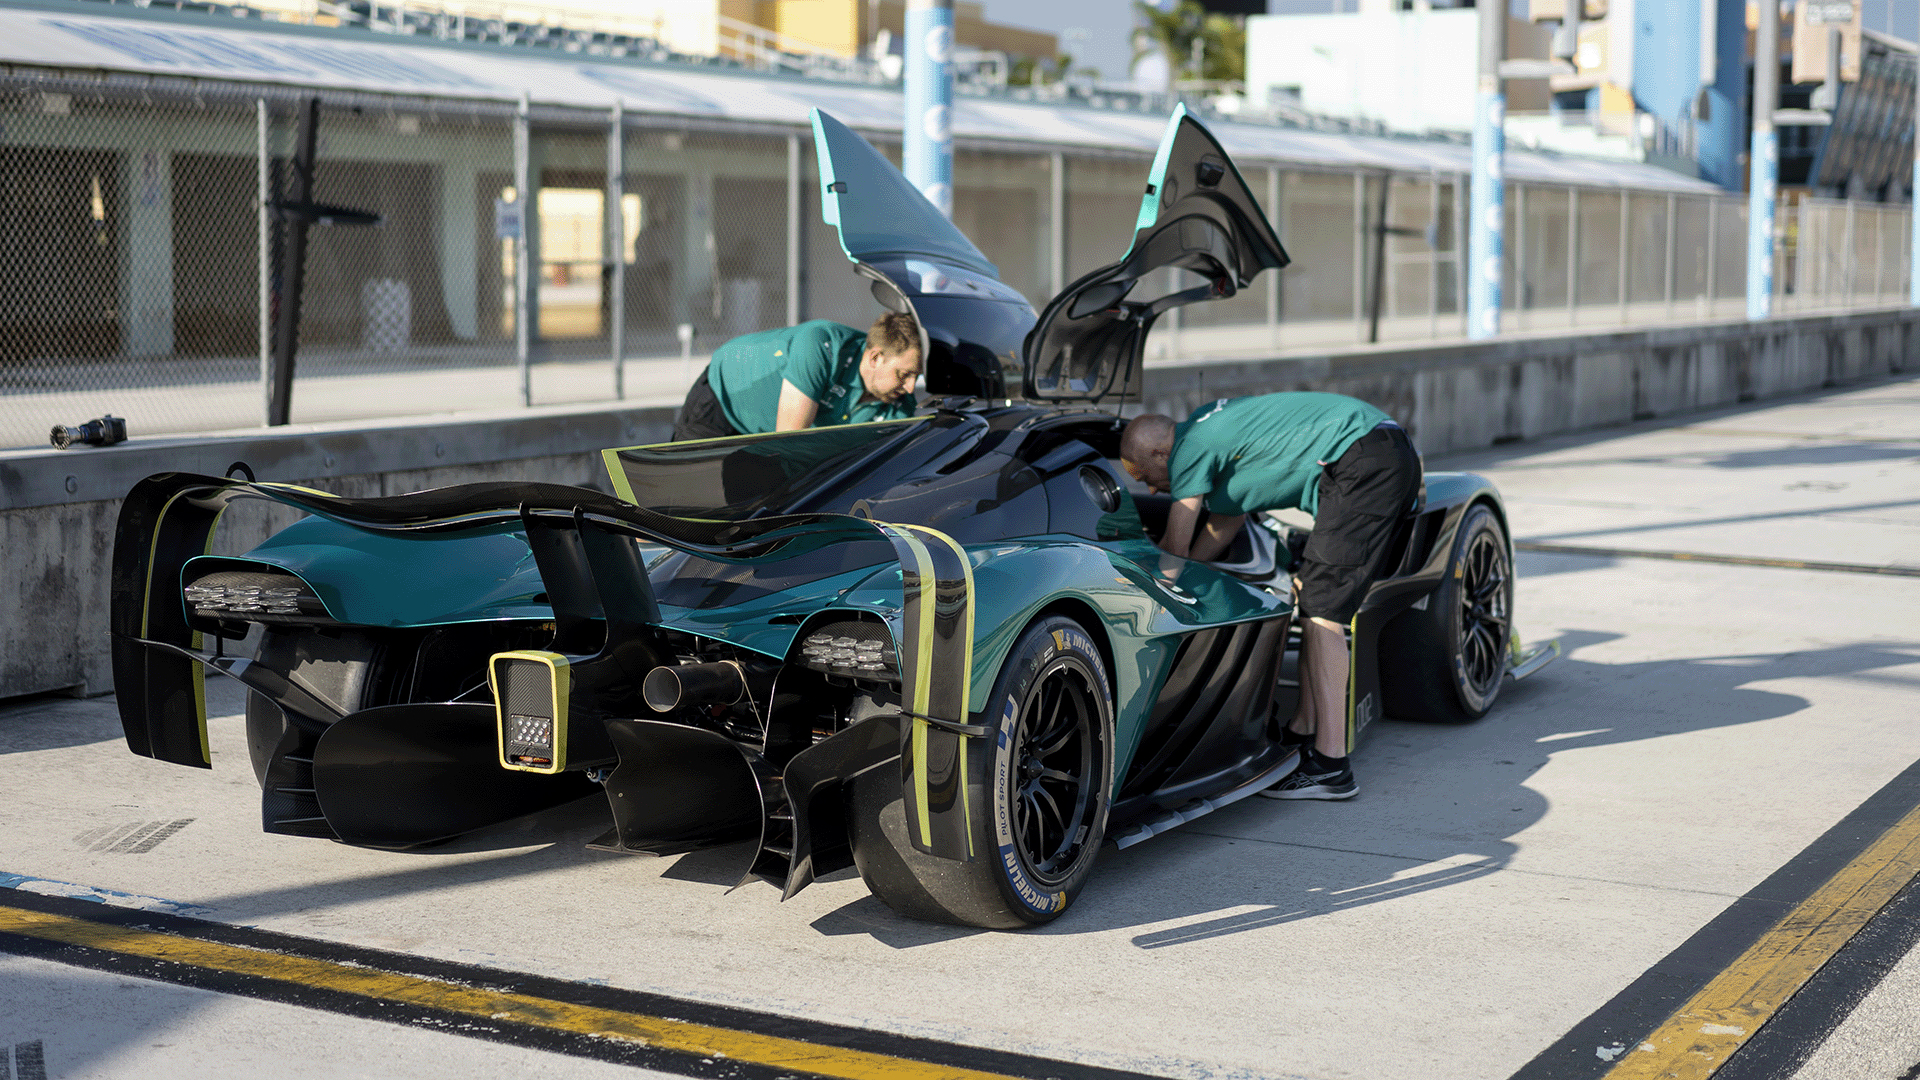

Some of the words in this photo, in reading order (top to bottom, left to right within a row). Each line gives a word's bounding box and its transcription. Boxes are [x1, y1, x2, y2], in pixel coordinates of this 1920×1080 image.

[1073, 634, 1110, 693] MICHELIN
[998, 760, 1006, 801] SPORT
[999, 804, 1008, 836] PILOT
[1005, 852, 1050, 911] MICHELIN
